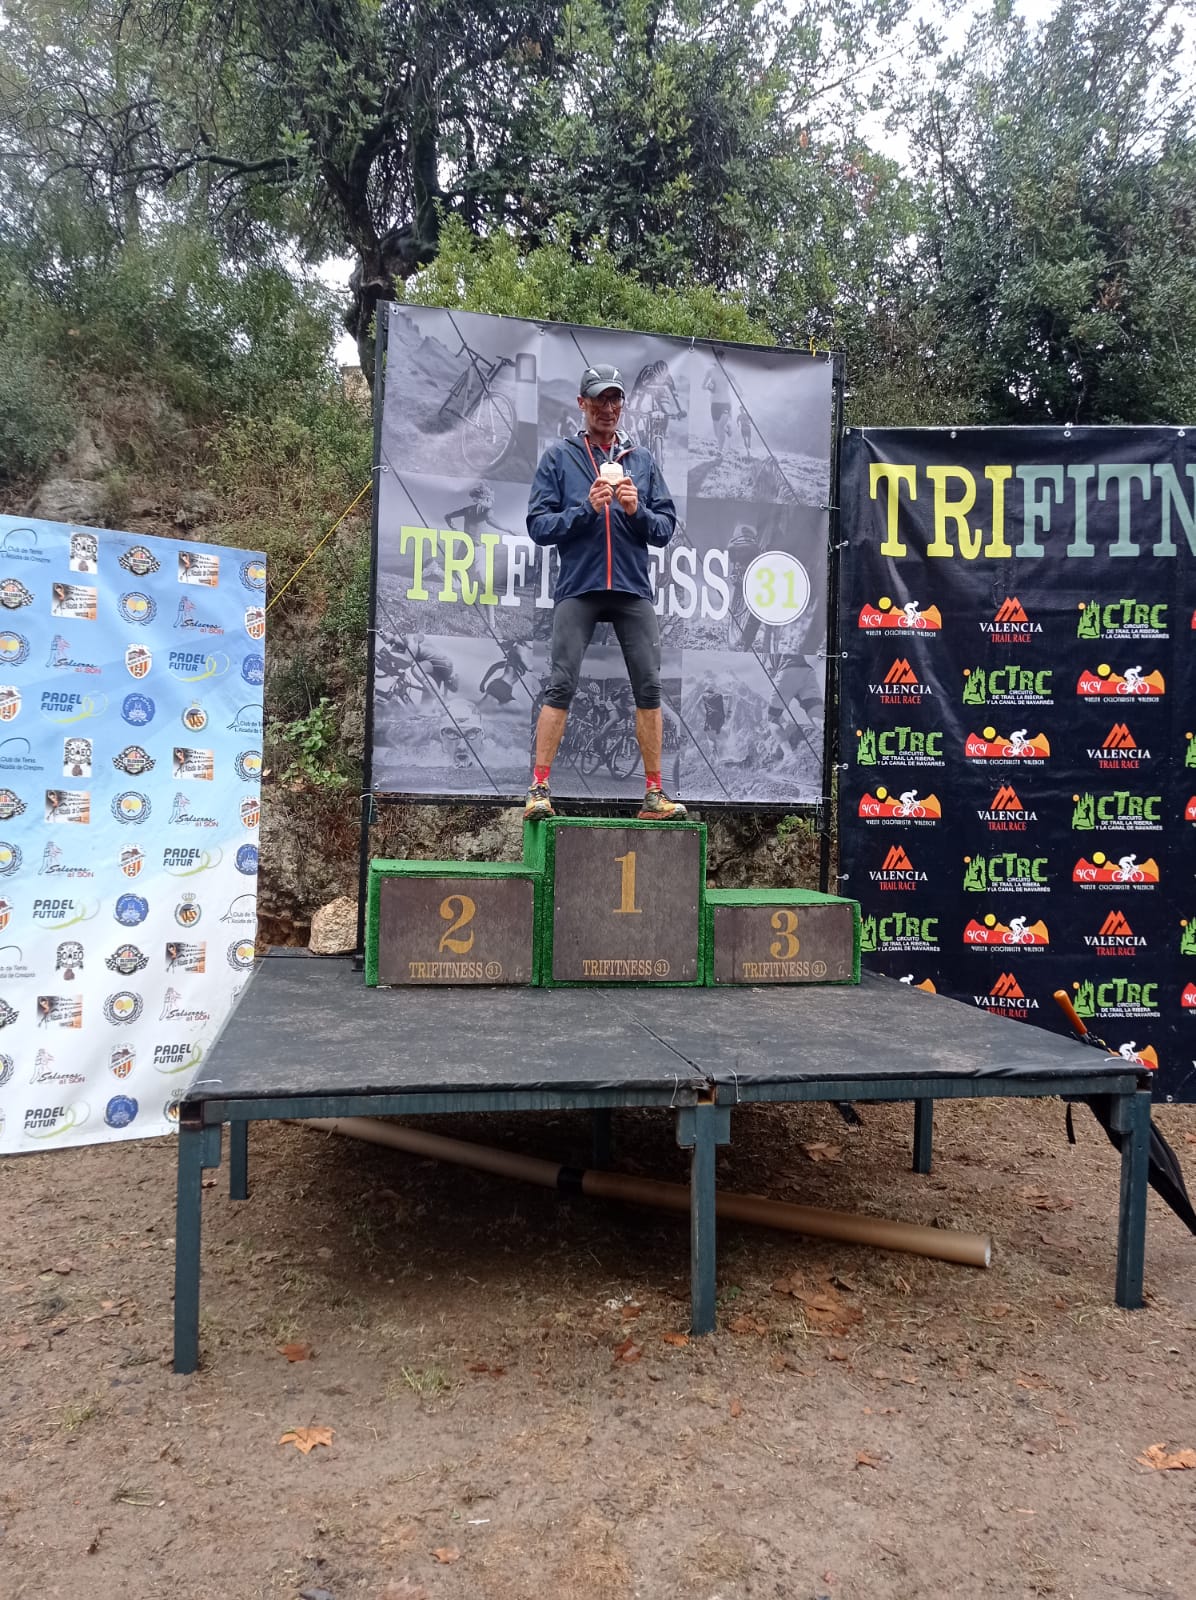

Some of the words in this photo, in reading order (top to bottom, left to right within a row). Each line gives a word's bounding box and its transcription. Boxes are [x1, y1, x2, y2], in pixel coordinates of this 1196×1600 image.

[869, 463, 1196, 560] TRIFITN
[400, 526, 730, 621] TRIFIESS
[755, 567, 798, 609] 31
[1103, 599, 1168, 628] CTRC
[979, 622, 1043, 632] VALENCIA
[992, 634, 1010, 643] TRAIL
[1013, 634, 1030, 643] RACE
[169, 652, 206, 664] PADEL
[169, 662, 198, 671] FUTUR
[989, 665, 1052, 694] CTRC
[869, 685, 932, 694] VALENCIA
[41, 692, 82, 704] PADEL
[880, 696, 901, 704] TRAIL
[903, 696, 921, 704] RACE
[40, 703, 73, 712] FUTUR
[879, 727, 942, 755] CTRC
[1086, 749, 1151, 759] VALENCIA
[1099, 760, 1119, 768] TRAIL
[1121, 760, 1139, 768] RACE
[1098, 791, 1161, 820] CTRC
[977, 810, 1038, 820] VALENCIA
[988, 821, 1008, 830] TRAIL
[1009, 821, 1026, 830] RACE
[164, 848, 200, 858] PADEL
[163, 858, 192, 866] FUTUR
[989, 853, 1048, 881] CTRC
[869, 871, 928, 881] VALENCIA
[612, 851, 643, 914] 1
[880, 881, 898, 890] TRAIL
[899, 881, 916, 890] RACE
[33, 899, 75, 910] PADEL
[32, 910, 66, 919] FUTUR
[439, 894, 476, 954] 2
[880, 912, 938, 941] CTRC
[769, 910, 798, 959] 3
[1084, 936, 1147, 946] VALENCIA
[1096, 946, 1116, 956] TRAIL
[1118, 946, 1136, 956] RACE
[408, 961, 483, 978] TRIFITNESS
[582, 959, 653, 976] TRIFITNESS
[742, 961, 810, 978] TRIFITNESS
[1097, 978, 1158, 1007] CTRC
[974, 996, 1039, 1008] VALENCIA
[1009, 1008, 1028, 1018] RACE
[154, 1044, 191, 1055] PADEL
[153, 1054, 183, 1064] FUTUR
[25, 1107, 65, 1120] PADEL
[24, 1118, 56, 1129] FUTUR
